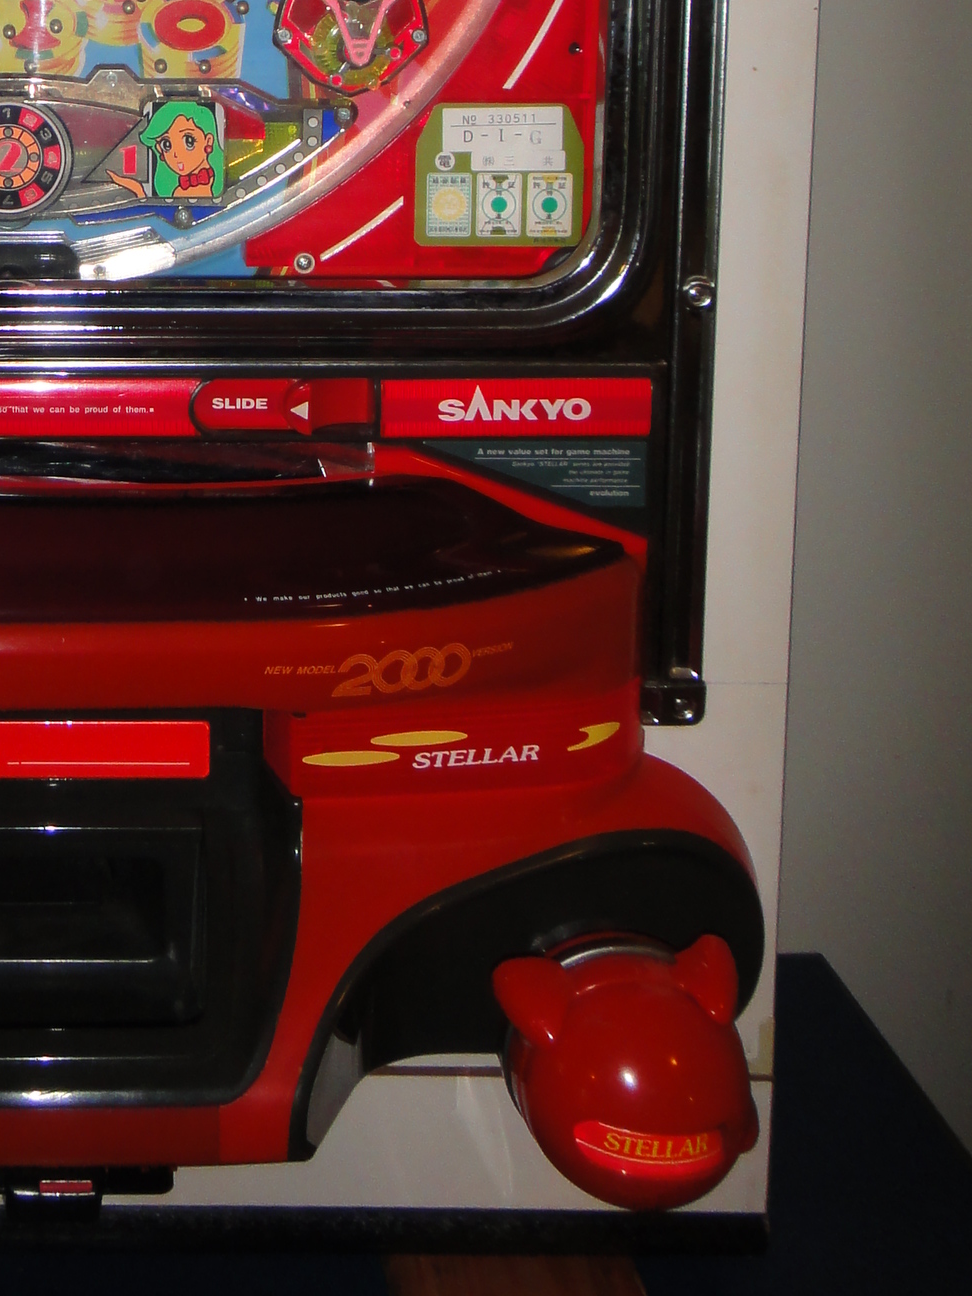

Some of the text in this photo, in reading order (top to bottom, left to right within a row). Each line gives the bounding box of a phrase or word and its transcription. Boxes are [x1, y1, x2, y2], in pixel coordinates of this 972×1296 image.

[488, 113, 537, 124] 330511
[119, 144, 137, 176] 1
[212, 397, 268, 410] SLIDE
[438, 384, 591, 422] SANKYO
[12, 405, 29, 414] that
[33, 406, 45, 414] we
[49, 406, 66, 414] can
[69, 405, 81, 414] be
[84, 405, 109, 415] proud
[113, 405, 122, 414] of
[566, 449, 591, 457] game
[589, 489, 630, 497] evolution
[316, 591, 347, 600] products
[264, 666, 293, 675] NEW
[296, 665, 336, 674] MODEL
[331, 642, 472, 697] 2000
[412, 744, 539, 769] STELLAR
[604, 1132, 708, 1158] STELLAR
